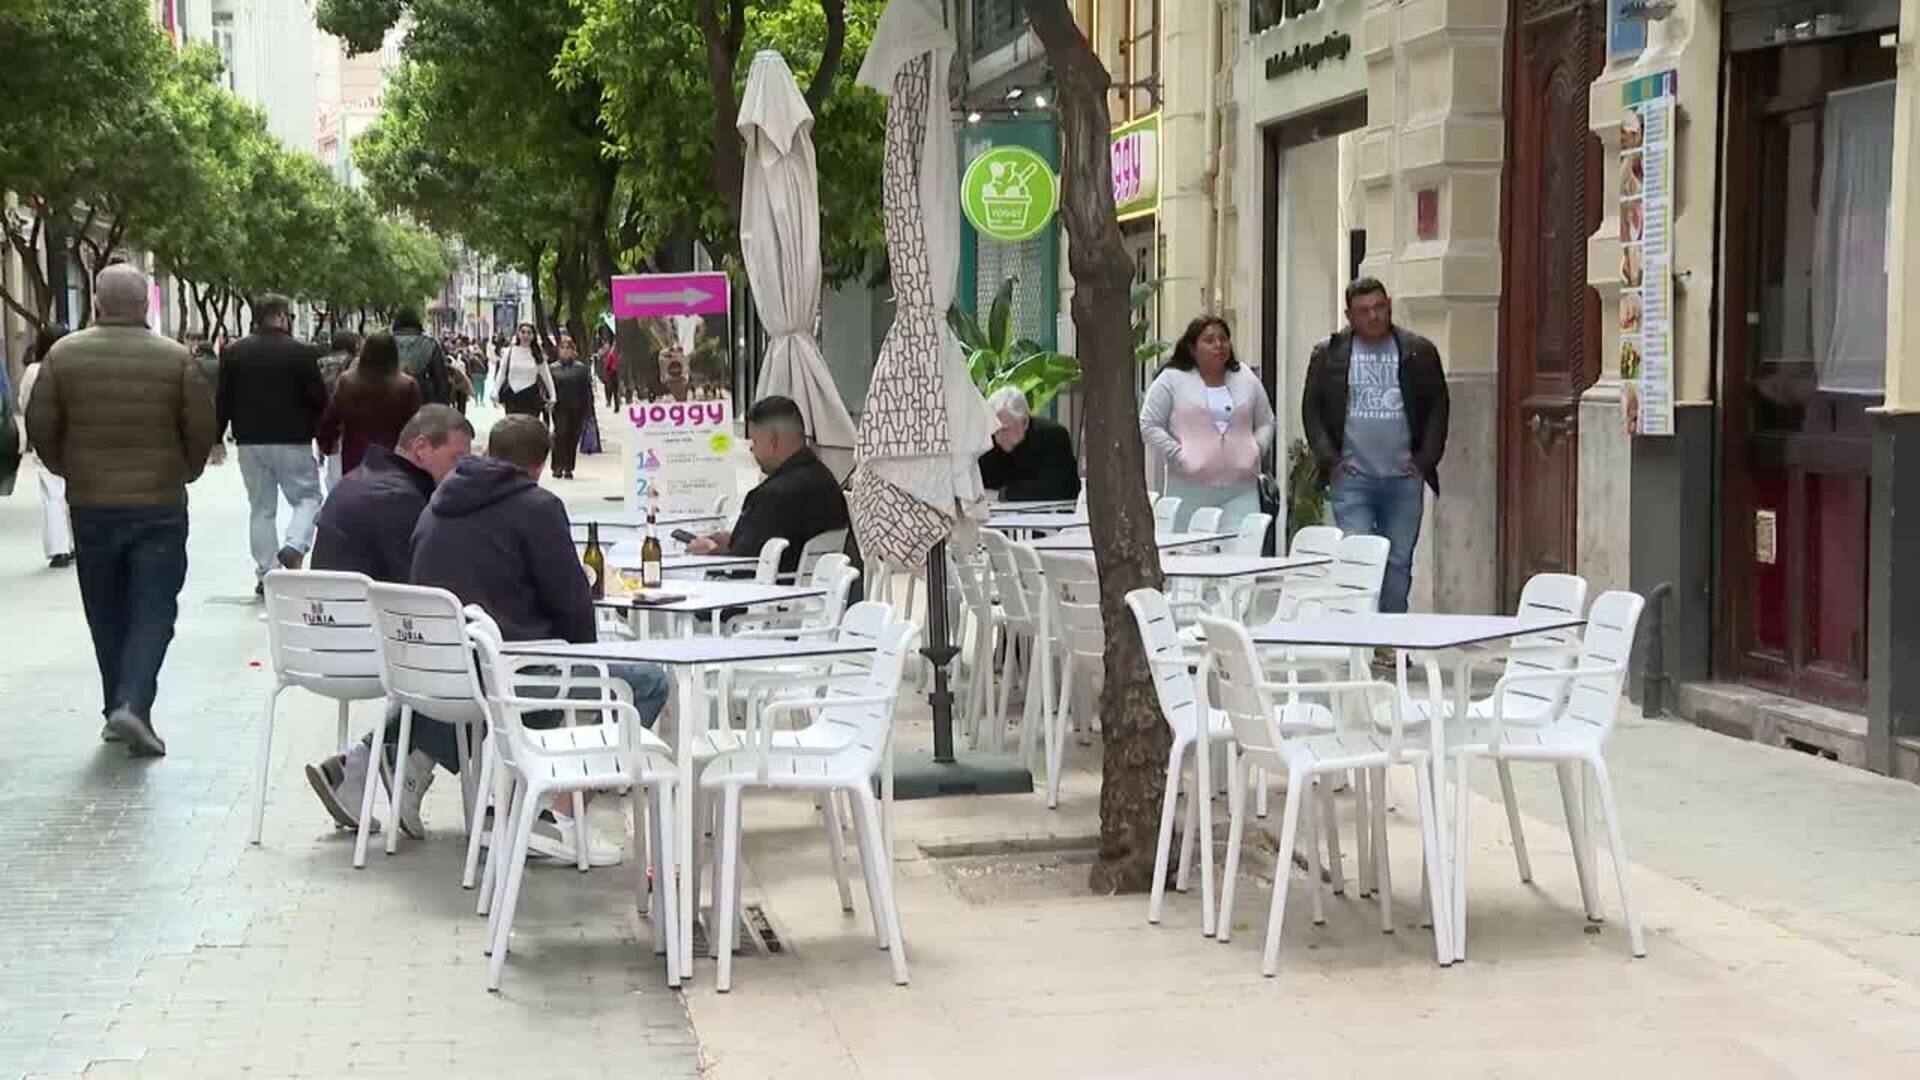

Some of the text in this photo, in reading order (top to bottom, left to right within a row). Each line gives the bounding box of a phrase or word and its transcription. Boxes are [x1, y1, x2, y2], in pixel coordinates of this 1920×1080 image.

[629, 403, 723, 427] yoggy
[635, 452, 645, 469] 1
[636, 479, 648, 496] 2
[301, 613, 335, 624] TURIA
[397, 629, 424, 640] TURIA
